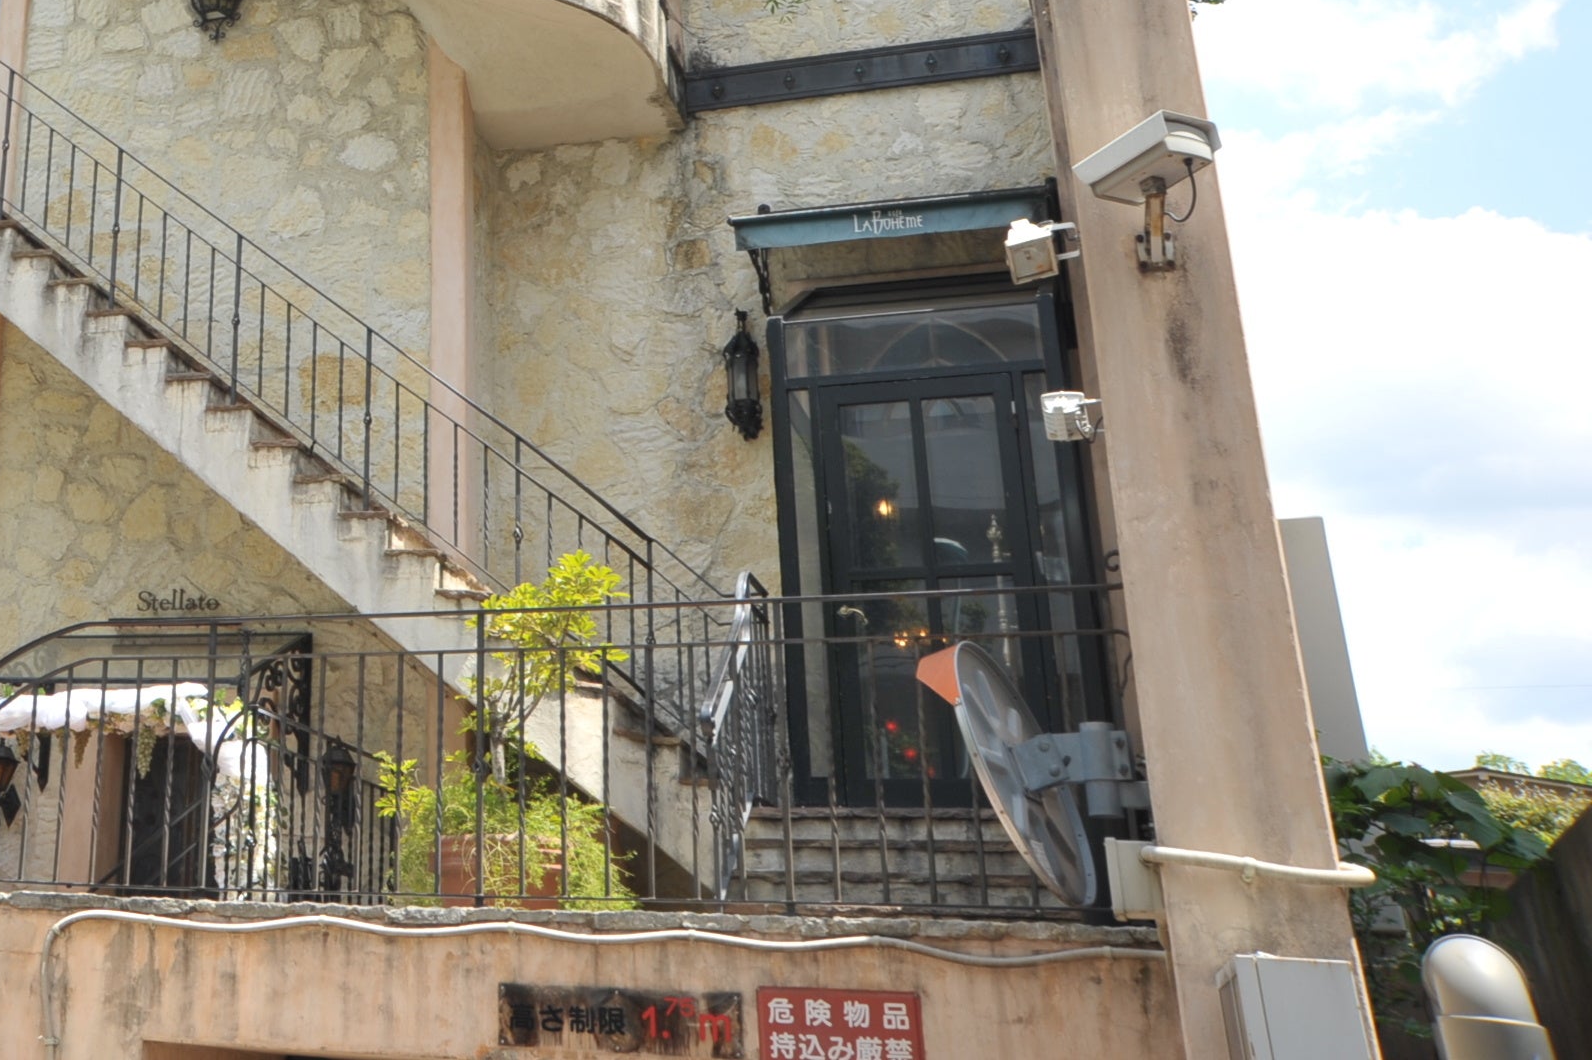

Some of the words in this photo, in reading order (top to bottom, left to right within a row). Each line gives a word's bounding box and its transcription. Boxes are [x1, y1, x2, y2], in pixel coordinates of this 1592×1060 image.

[136, 588, 221, 612] Stellato
[510, 1003, 627, 1036] 高さ制限
[767, 997, 911, 1031] 危険物品
[769, 1031, 915, 1060] 持込み厳禁
